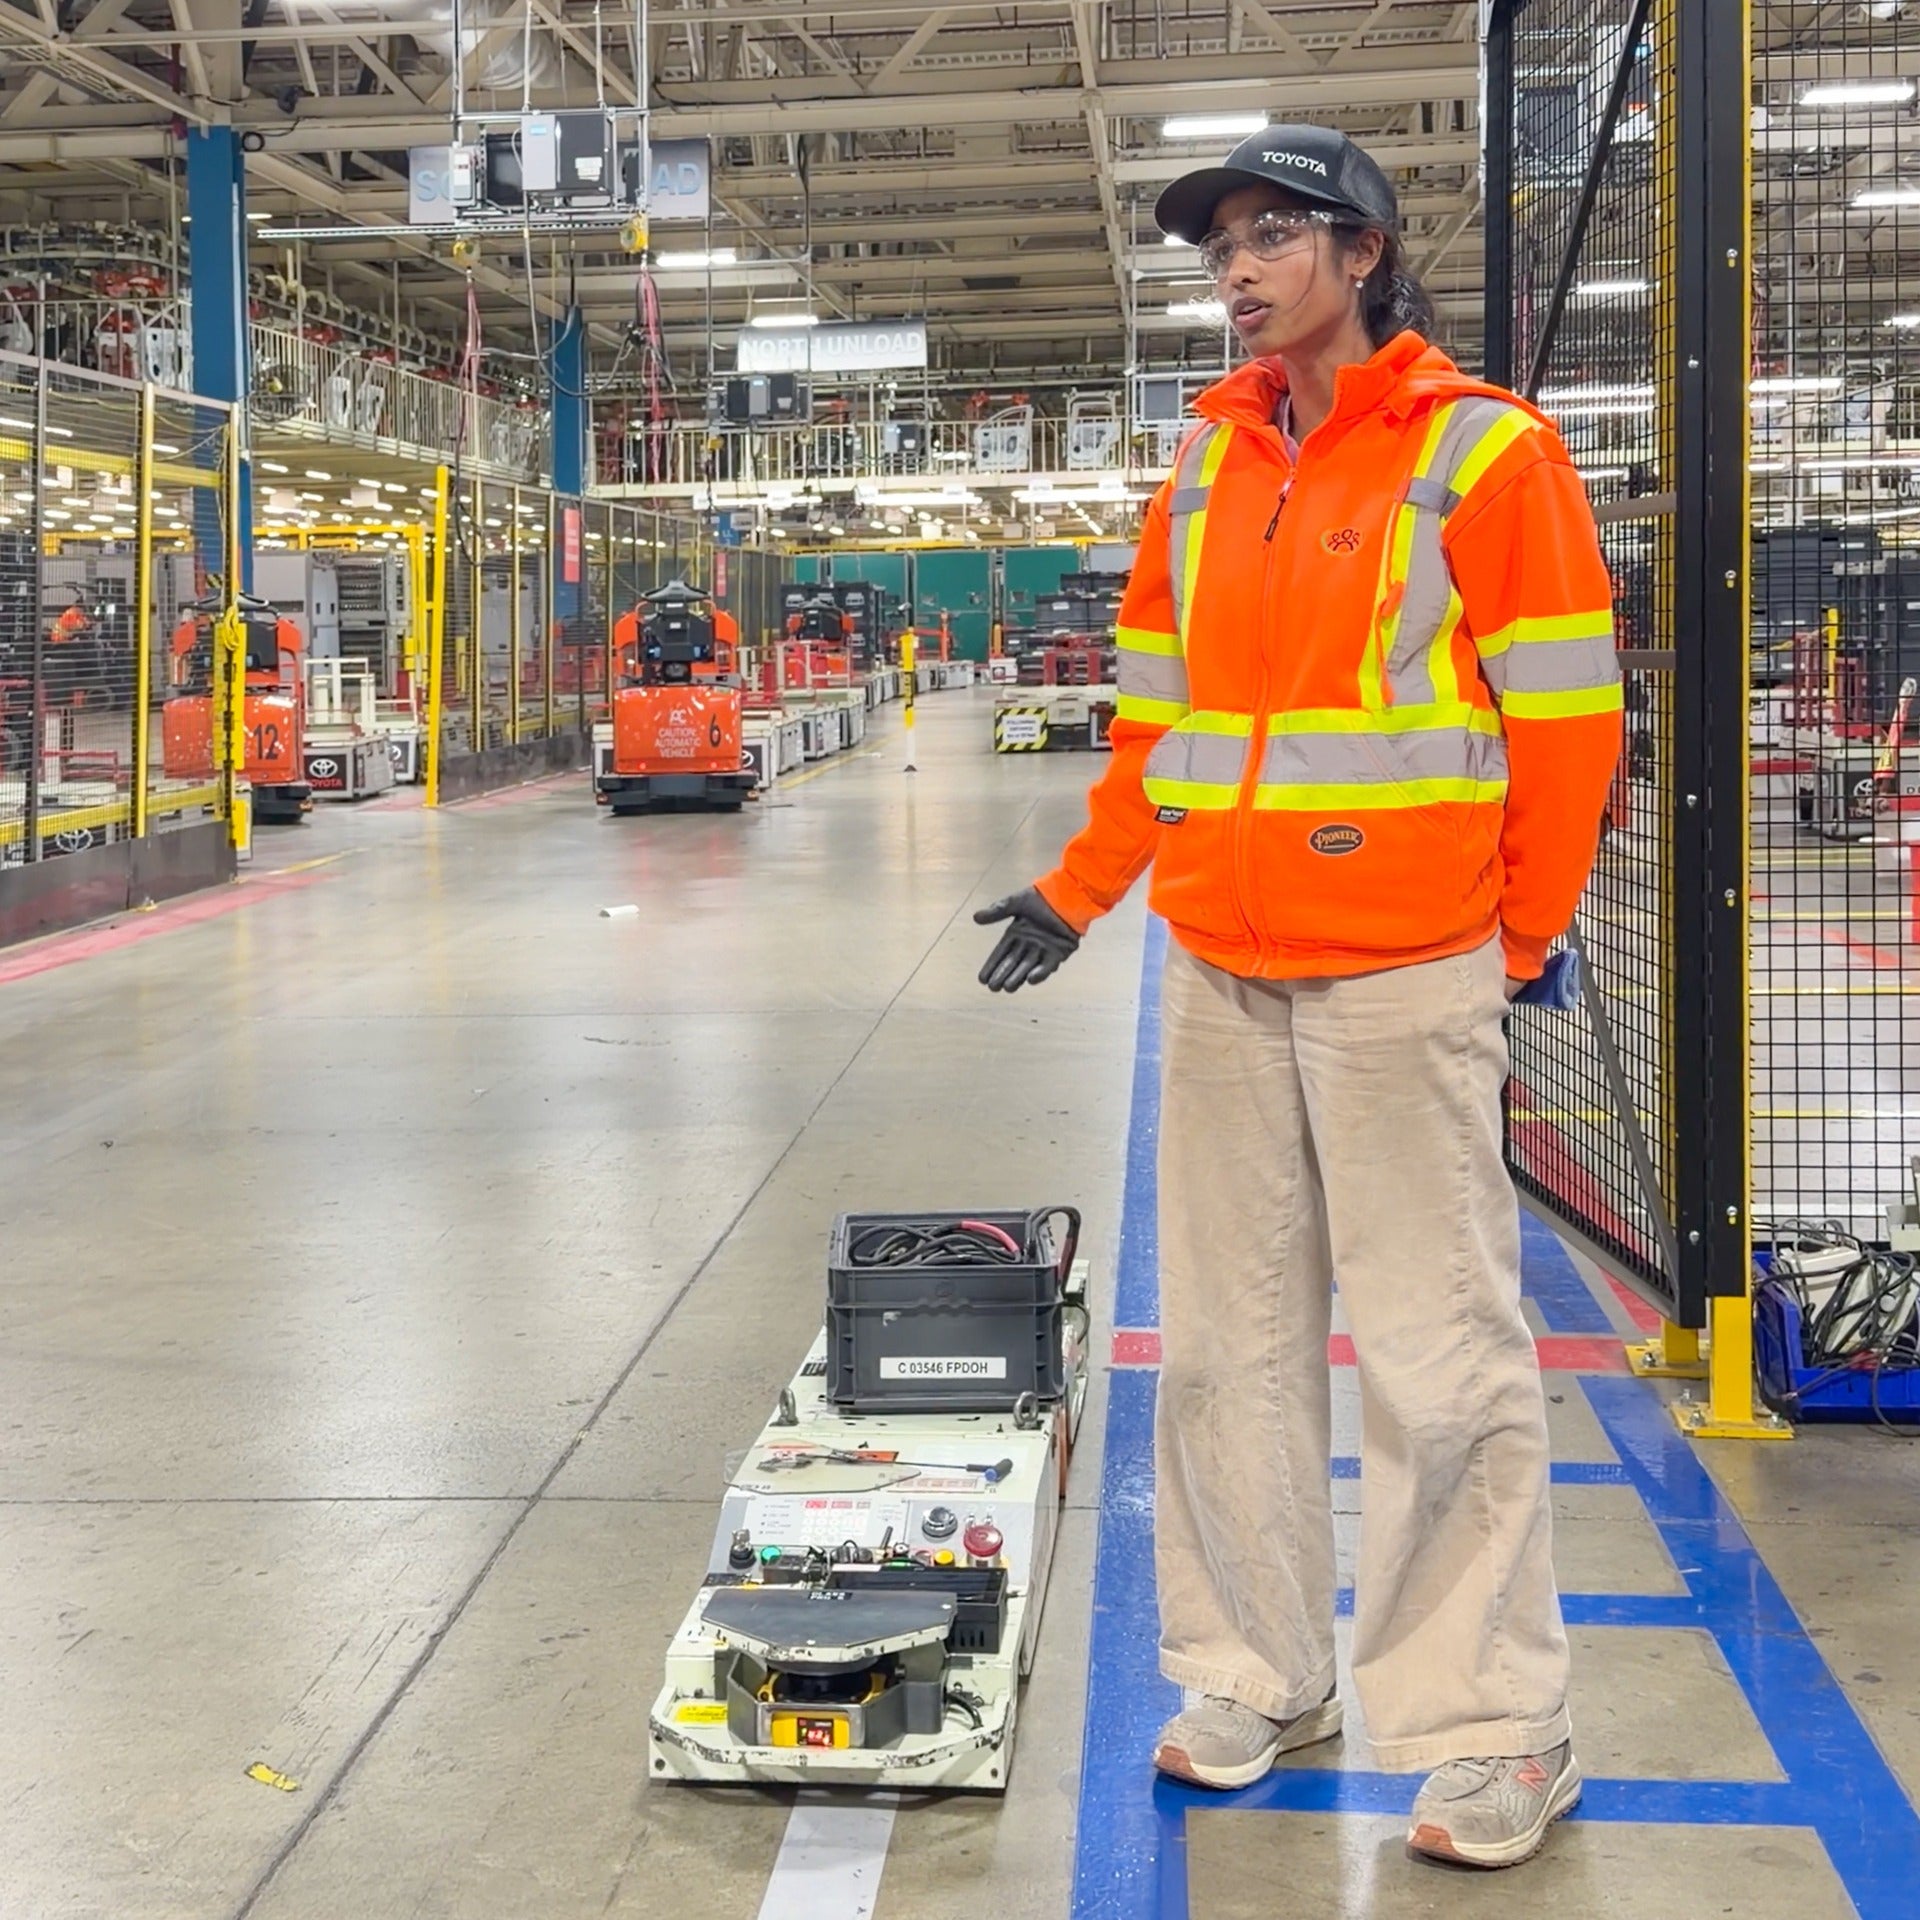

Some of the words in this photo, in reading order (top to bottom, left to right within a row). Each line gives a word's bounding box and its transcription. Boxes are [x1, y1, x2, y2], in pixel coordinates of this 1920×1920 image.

[1261, 151, 1327, 177] TOYOTA
[742, 335, 823, 359] NORTH
[828, 332, 922, 356] UNLOAD
[254, 722, 279, 761] 12
[709, 712, 721, 748] 6
[898, 1362, 906, 1374] C
[910, 1362, 943, 1374] 03546
[946, 1362, 988, 1374] FPDOH
